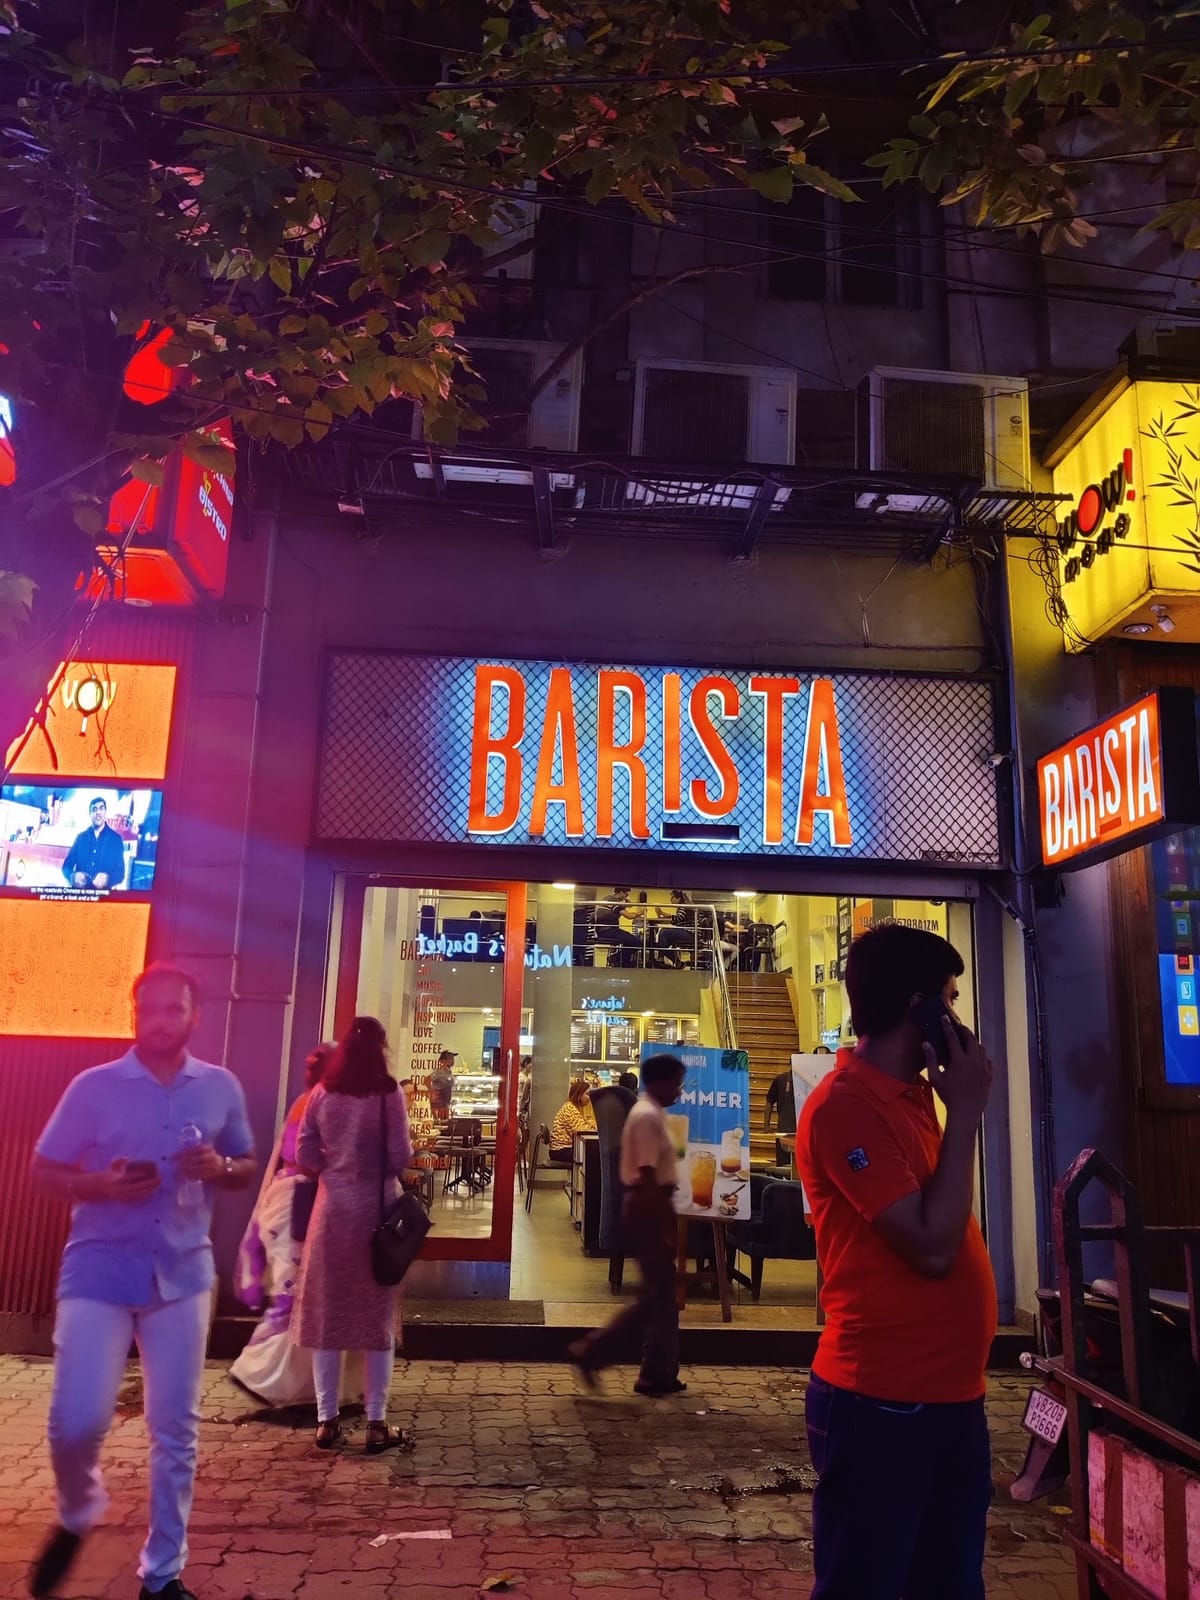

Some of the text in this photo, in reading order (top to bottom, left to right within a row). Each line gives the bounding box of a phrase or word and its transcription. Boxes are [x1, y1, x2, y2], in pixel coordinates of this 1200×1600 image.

[467, 664, 853, 847] BARISTA
[1043, 708, 1158, 857] BARISTA
[414, 1011, 457, 1024] INSPIRING
[413, 1027, 433, 1038] LOVE
[412, 1043, 443, 1054] COFFEE
[411, 1059, 444, 1070] CULTUR
[411, 1075, 431, 1086] FOO
[676, 1088, 743, 1109] MMER
[409, 1123, 431, 1135] DEAS
[1029, 1411, 1058, 1439] P3666
